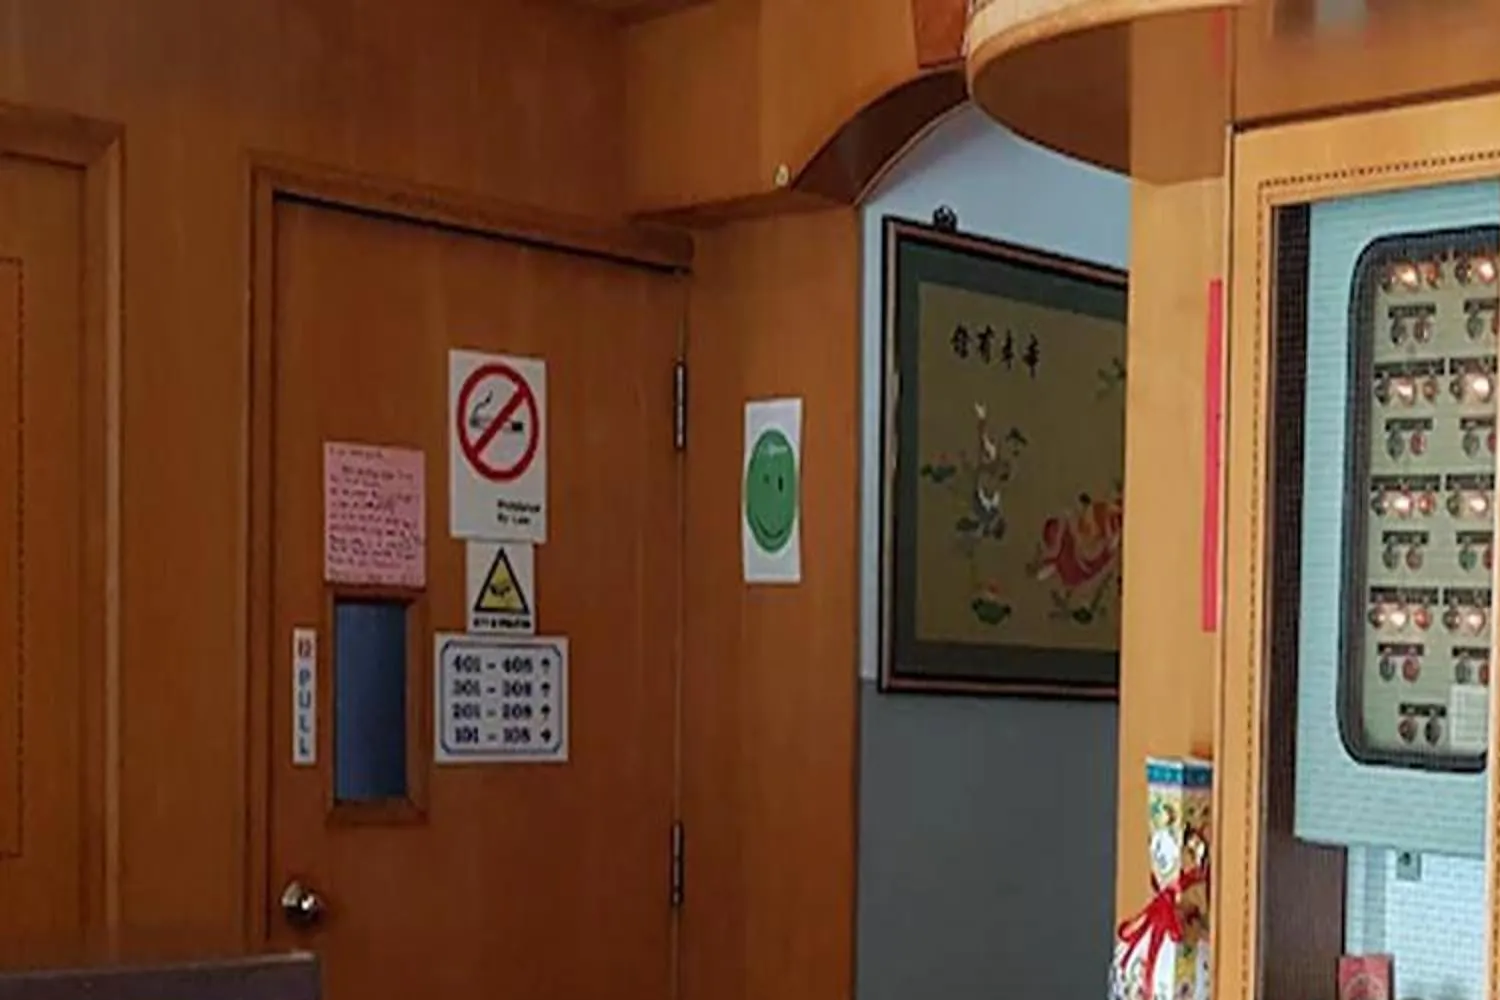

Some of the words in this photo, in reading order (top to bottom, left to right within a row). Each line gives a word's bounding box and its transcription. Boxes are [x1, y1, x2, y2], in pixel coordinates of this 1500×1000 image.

[452, 654, 481, 674] 401
[452, 678, 481, 698] 301
[298, 667, 312, 758] PULL
[451, 701, 481, 720] 201
[455, 725, 480, 744] 101
